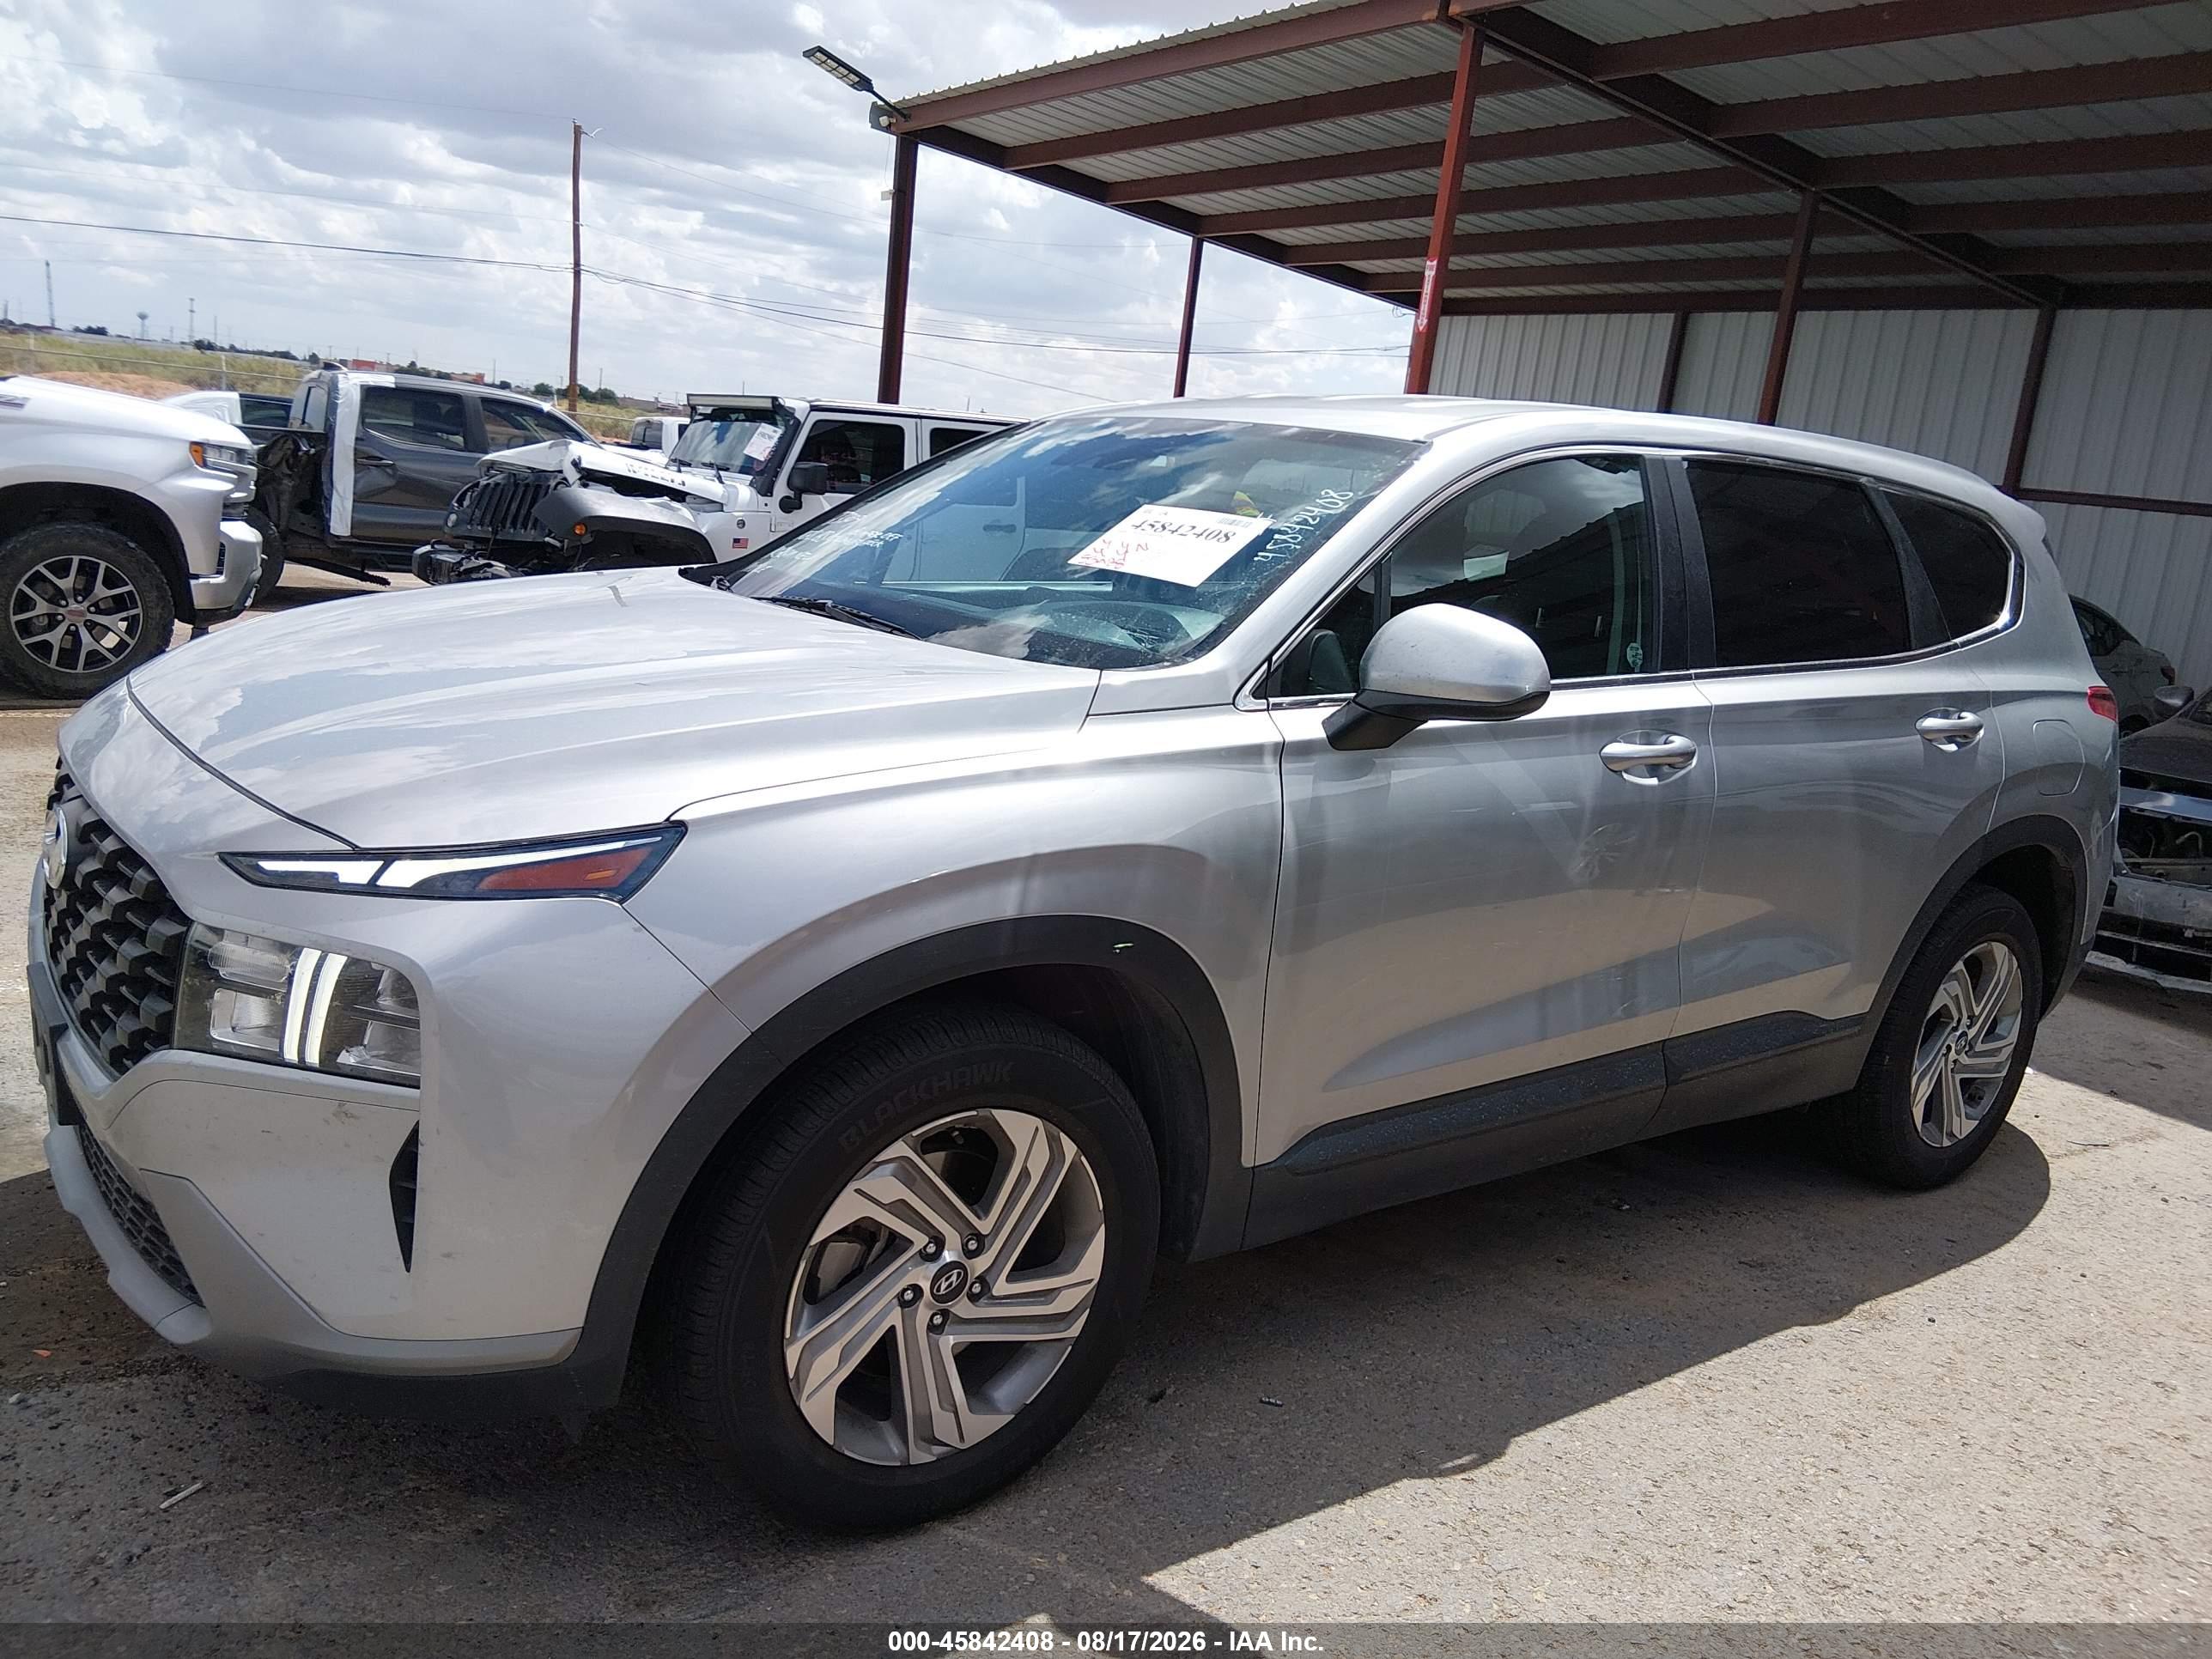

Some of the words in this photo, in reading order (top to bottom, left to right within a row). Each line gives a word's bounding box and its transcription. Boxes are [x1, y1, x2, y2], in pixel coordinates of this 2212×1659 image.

[1131, 519, 1237, 544] 45842408
[1254, 489, 1354, 562] 45842408
[838, 1061, 1015, 1152] BLACKHAWK
